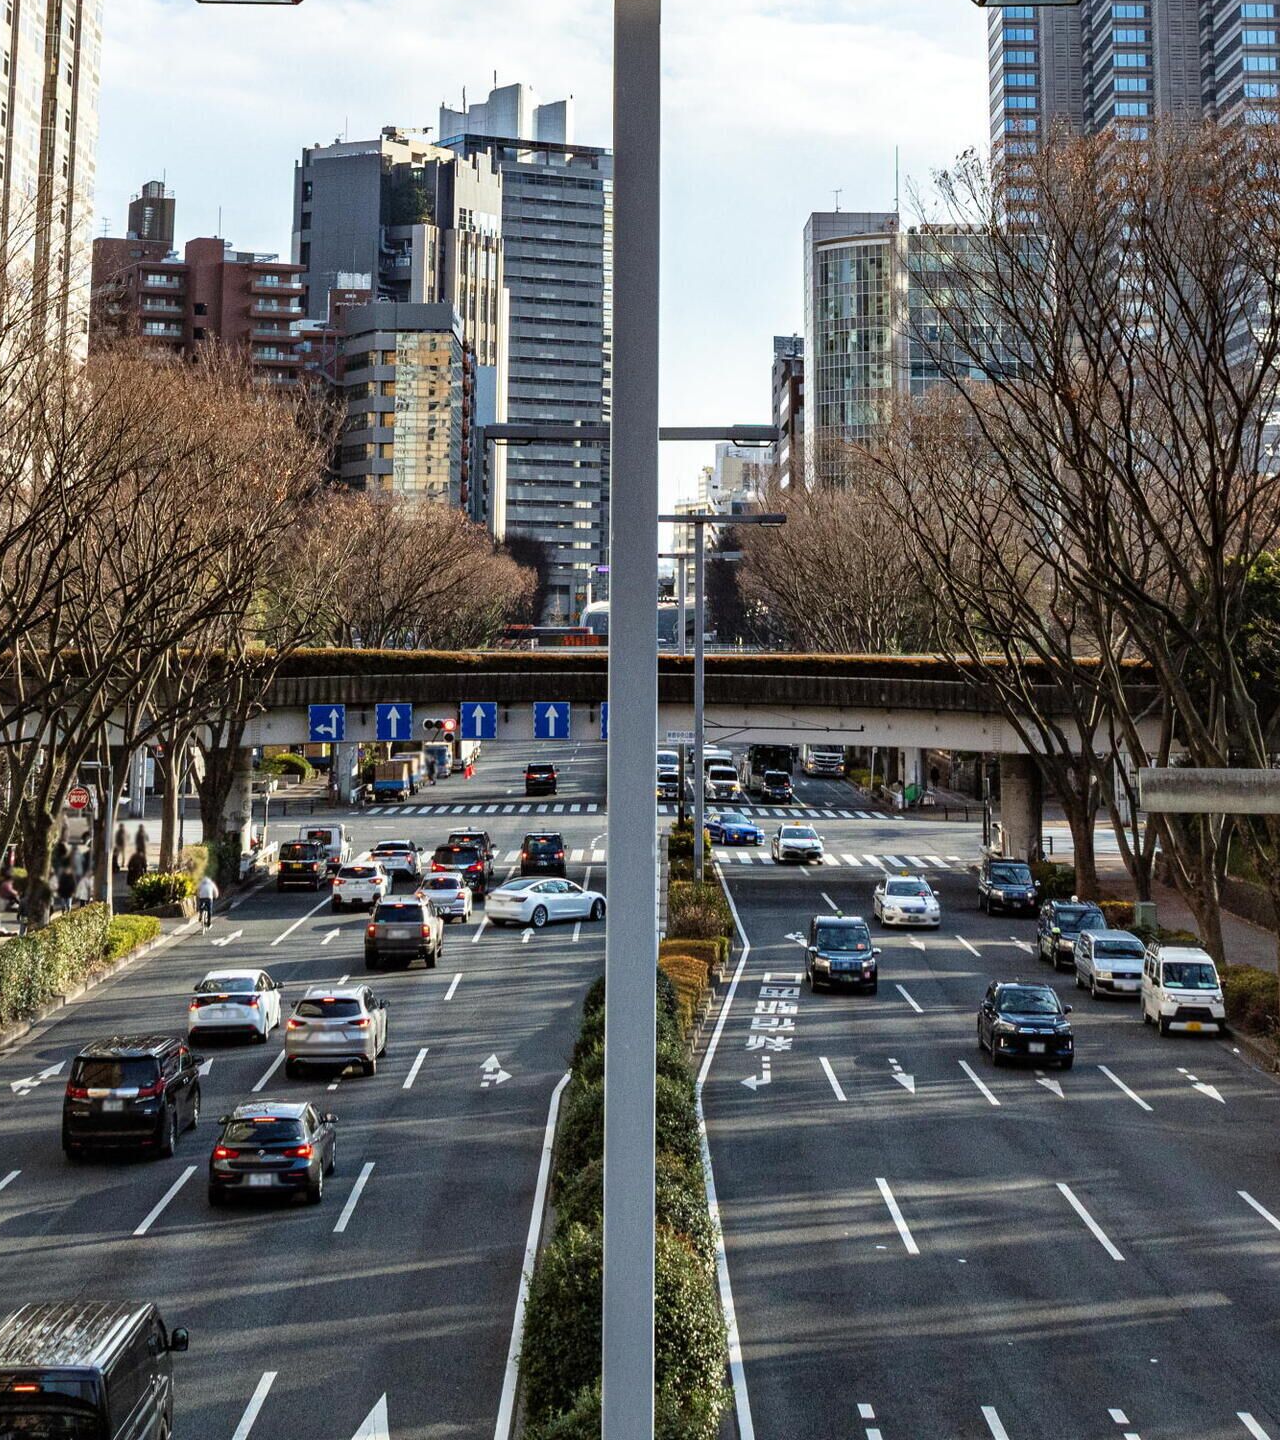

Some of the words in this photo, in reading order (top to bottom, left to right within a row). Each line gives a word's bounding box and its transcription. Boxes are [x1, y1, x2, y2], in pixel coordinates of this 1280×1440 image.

[745, 972, 803, 1052] 新宿駅西口
